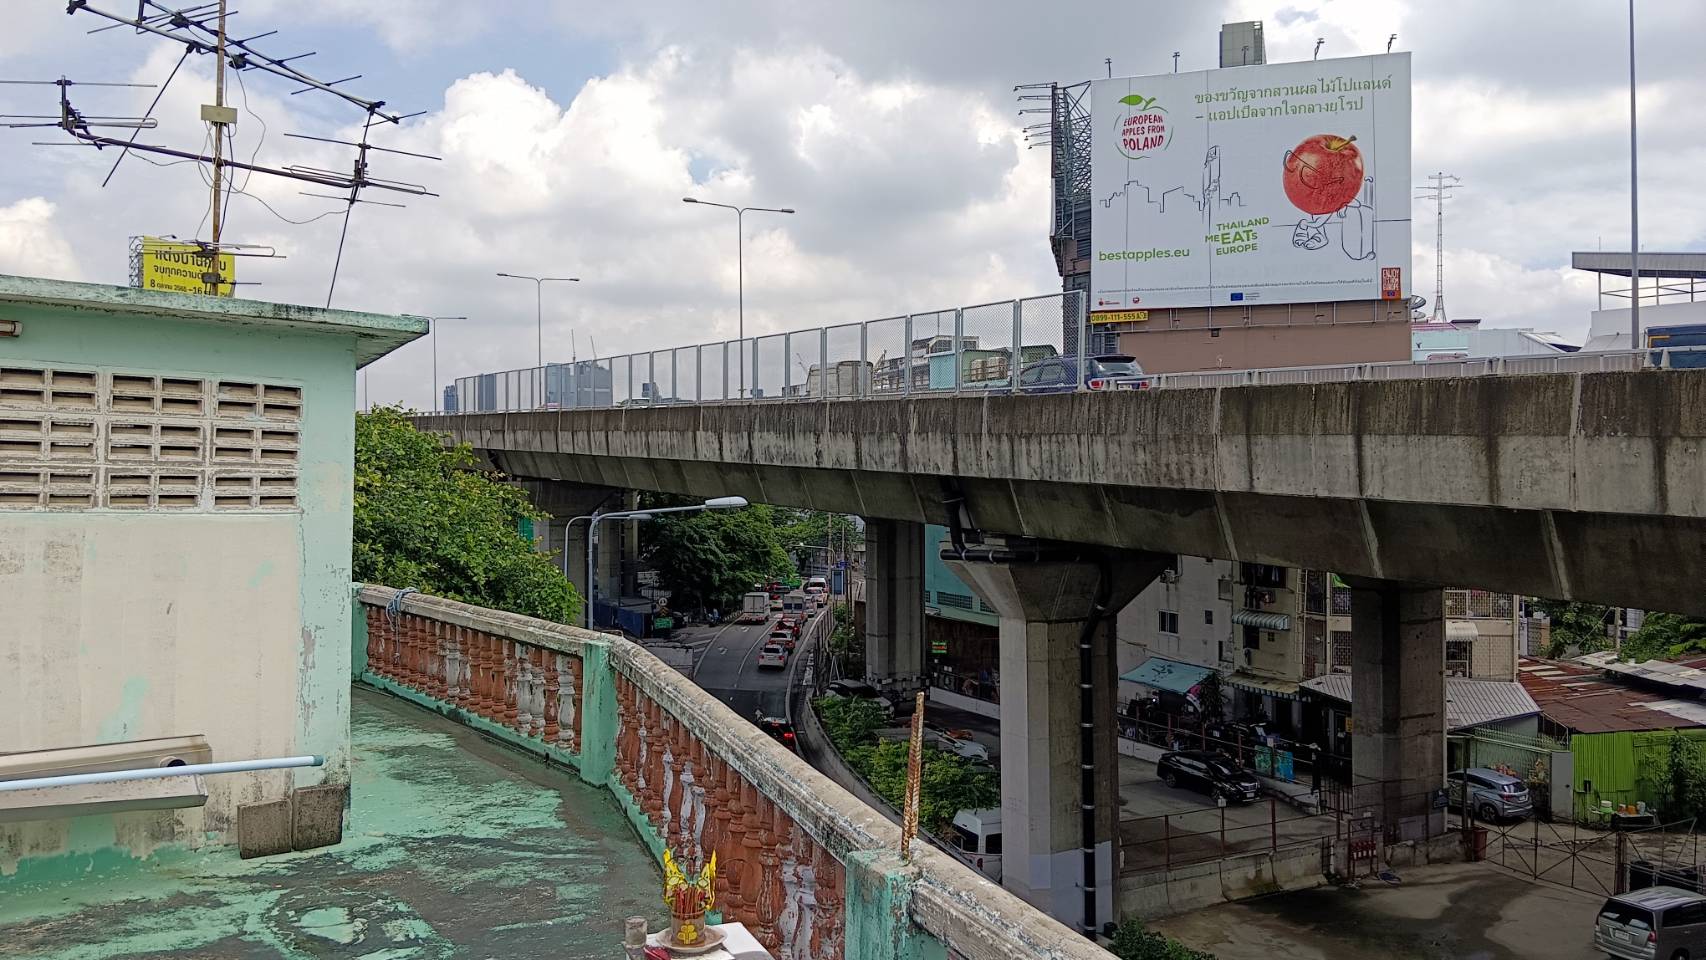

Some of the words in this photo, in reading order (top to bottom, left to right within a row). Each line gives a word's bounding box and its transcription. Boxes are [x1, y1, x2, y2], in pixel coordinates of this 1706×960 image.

[1194, 75, 1392, 104] ของขวัญจากสวนผลไม้โปแลนด์
[1123, 114, 1163, 126] EUROPEAN
[1122, 126, 1145, 136] APPLES
[1147, 125, 1165, 134] FROM
[1123, 135, 1164, 151] POLAND
[1216, 217, 1270, 231] THAILAND
[1099, 248, 1190, 262] bestapples.eu
[1216, 243, 1258, 256] EUROPE
[150, 279, 156, 288] 8
[192, 287, 203, 295] 16
[1091, 313, 1136, 322] 0899-111-555
